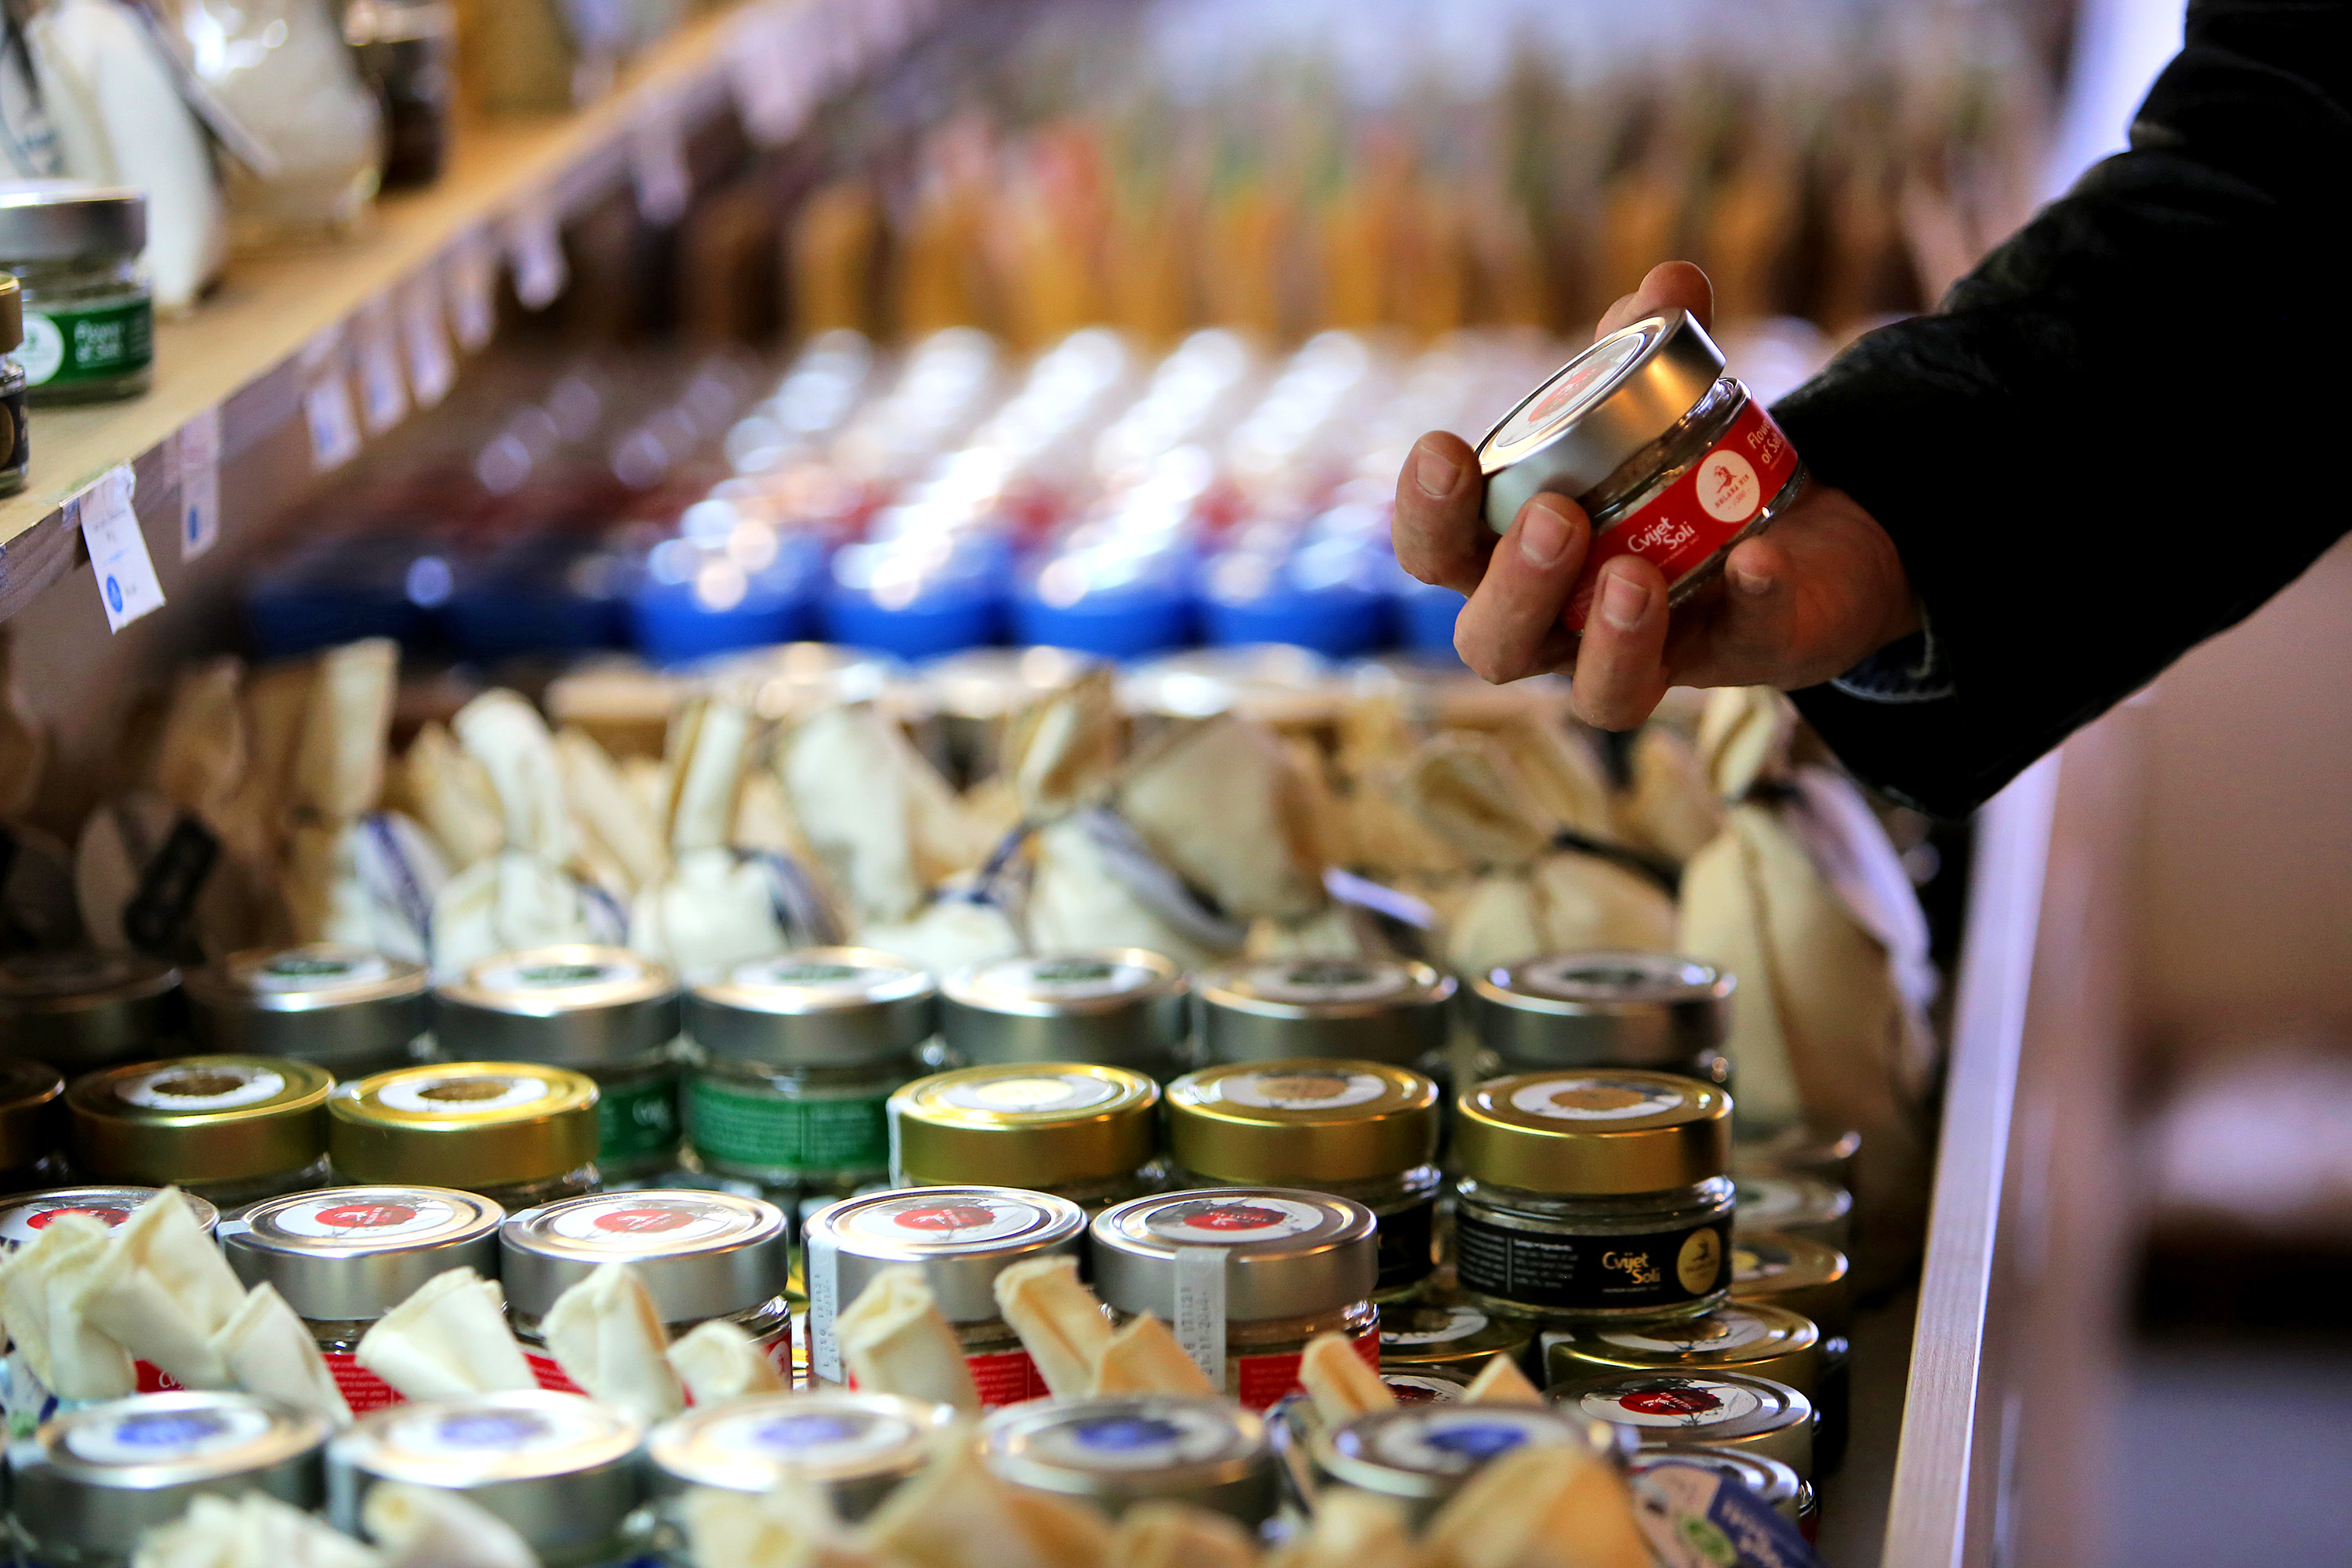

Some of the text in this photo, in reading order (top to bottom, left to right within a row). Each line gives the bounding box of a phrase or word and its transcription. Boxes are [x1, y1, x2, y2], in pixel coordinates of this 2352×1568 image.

[1747, 419, 1771, 449] Flowe
[1762, 445, 1772, 464] of
[1628, 517, 1675, 553] Cvijet
[1663, 521, 1696, 550] Soli
[1602, 1251, 1650, 1274] Cvijet
[1631, 1267, 1661, 1284] Soli
